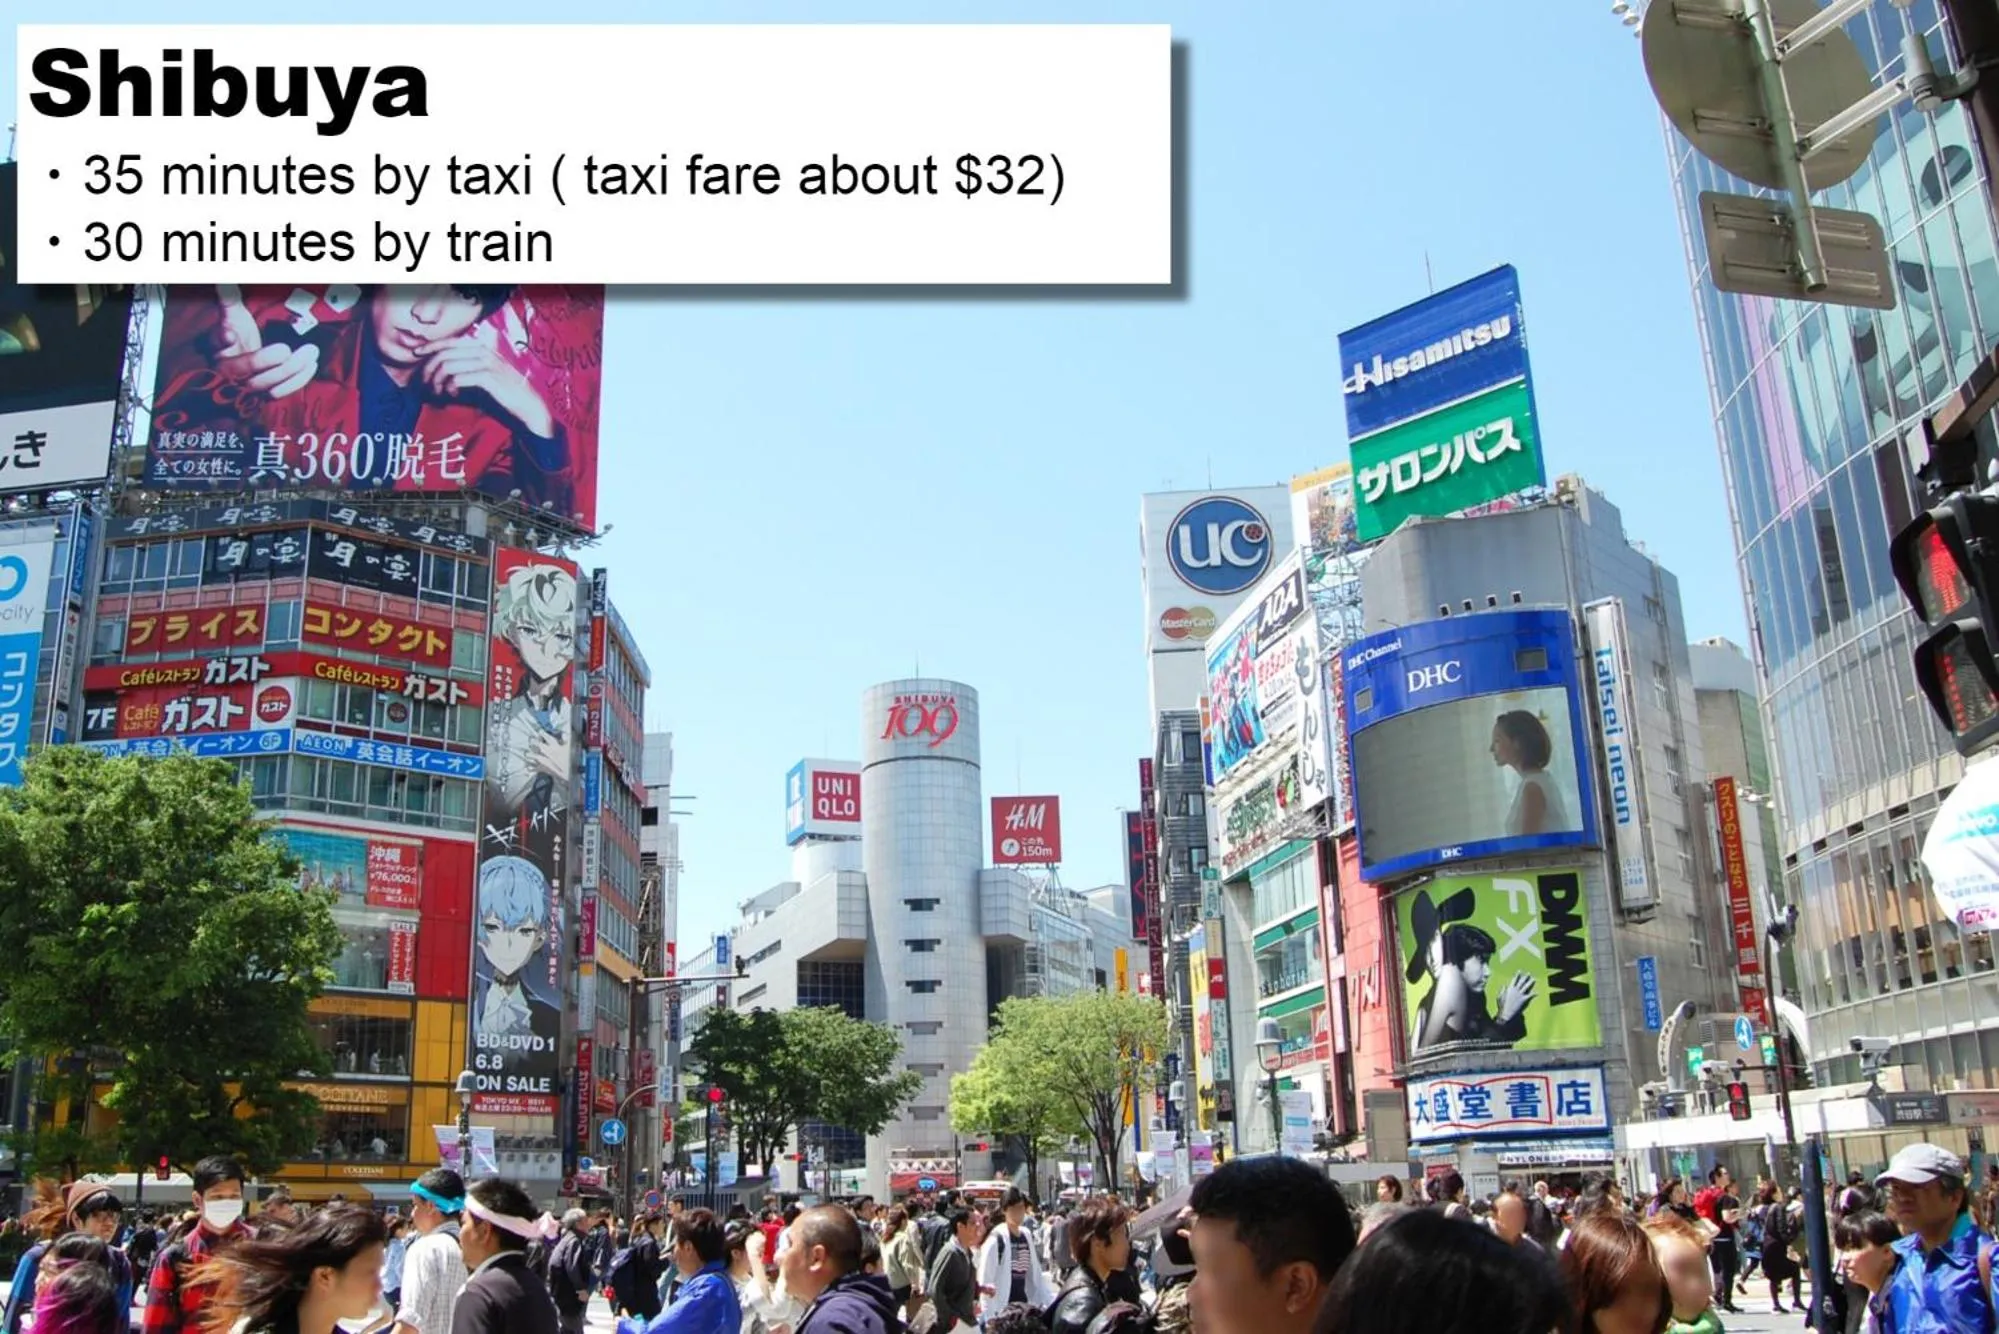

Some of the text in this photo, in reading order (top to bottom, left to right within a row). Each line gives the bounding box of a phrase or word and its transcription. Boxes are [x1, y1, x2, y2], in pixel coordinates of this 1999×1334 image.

[1344, 315, 1511, 393] Hisamitsu
[0, 430, 47, 470] き
[1357, 416, 1521, 503] サロンパス
[0, 604, 34, 624] city
[131, 609, 260, 646] プライス
[304, 607, 447, 656] コンタクト
[204, 656, 270, 684] ガスト
[1408, 661, 1461, 692] DHC
[403, 674, 468, 705] ガスト
[895, 695, 956, 704] SHIBUYA
[87, 707, 117, 729] 7F
[161, 695, 243, 733] ガスト
[880, 703, 958, 748] 109
[303, 734, 346, 752] AEON
[356, 741, 481, 774] 英会話イーオン
[818, 777, 851, 795] UNI
[818, 797, 855, 817] QLO
[1005, 803, 1045, 831] H&M
[1022, 846, 1052, 857] 150m
[1493, 878, 1542, 963] FX
[1537, 873, 1590, 1007] DMM
[476, 1033, 555, 1051] BD&DVD 1
[475, 1054, 503, 1069] 6.8
[476, 1075, 551, 1092] ON SALE
[1414, 1080, 1592, 1125] 大盛堂書店
